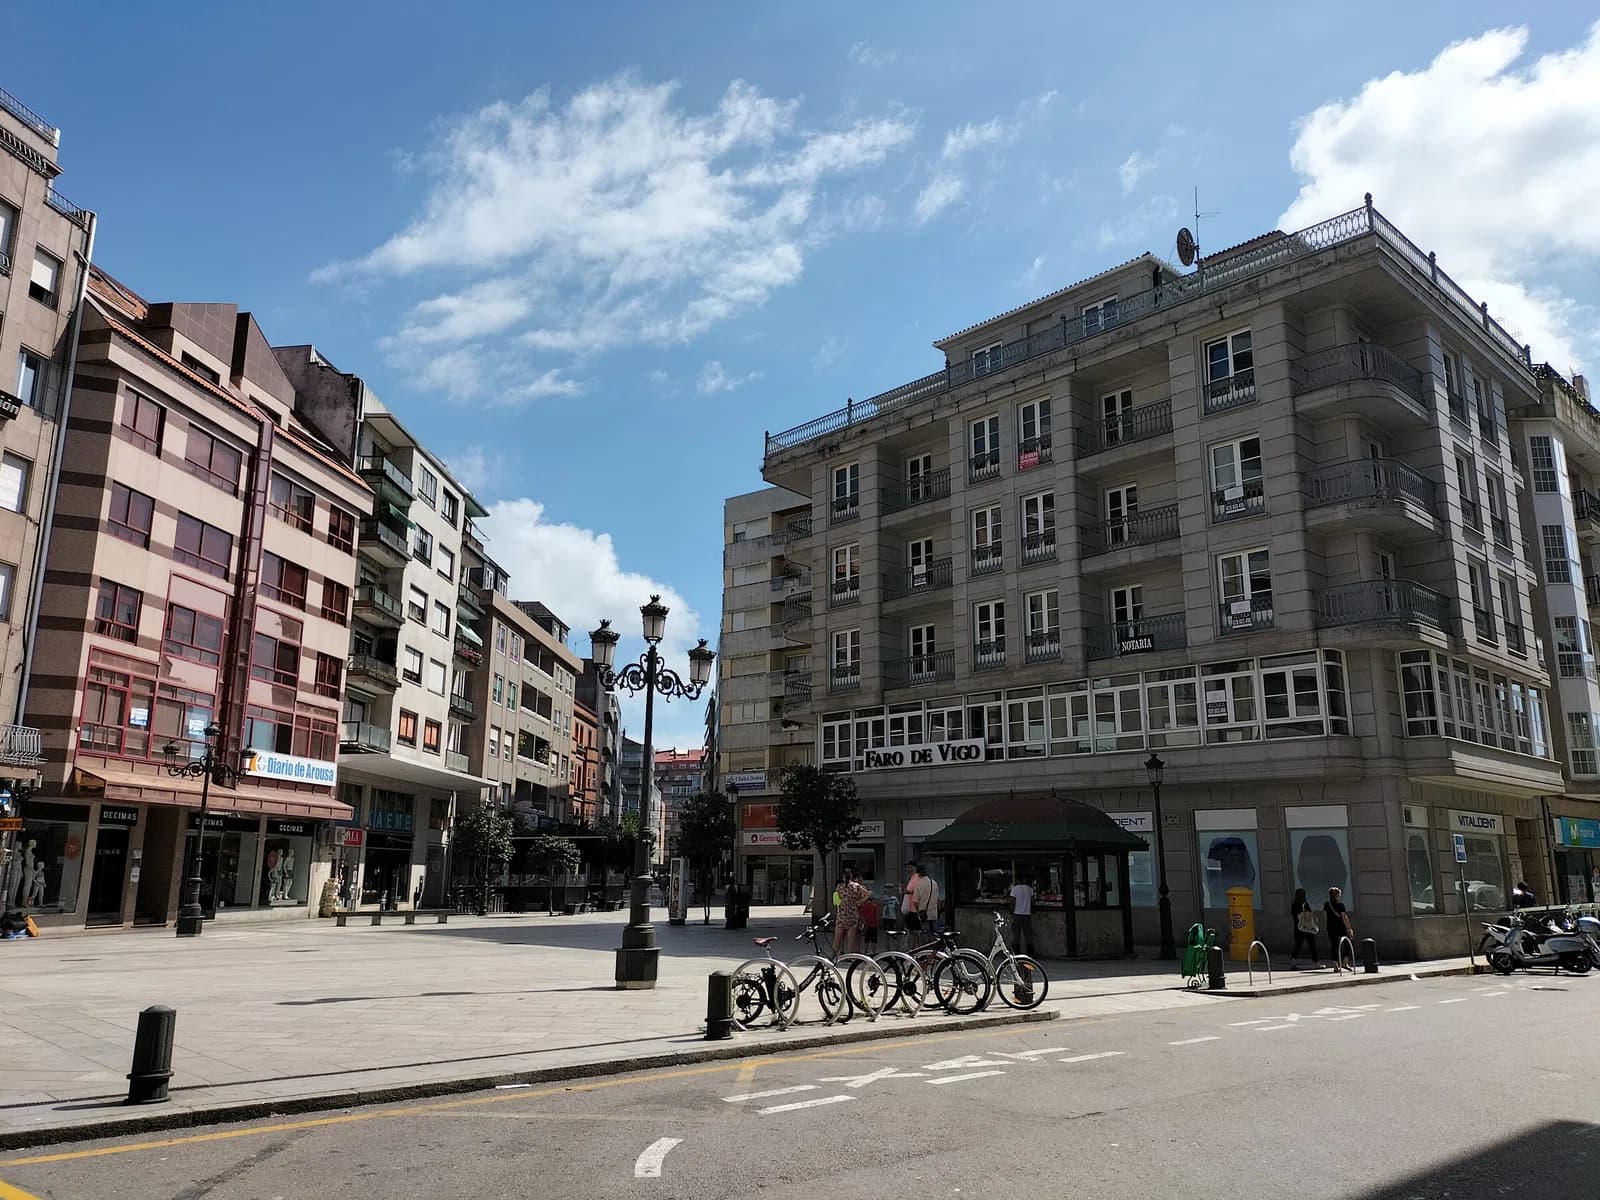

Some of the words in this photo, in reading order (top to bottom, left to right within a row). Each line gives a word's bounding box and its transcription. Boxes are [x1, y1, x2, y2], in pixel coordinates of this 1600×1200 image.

[865, 750, 904, 768] FARO
[910, 748, 932, 764] DE
[938, 743, 980, 761] VIGO
[267, 757, 293, 776] Diario
[295, 761, 304, 777] de
[306, 763, 334, 782] Arousa
[195, 818, 224, 827] DCIMAS
[1458, 815, 1496, 829] VITALDENT
[860, 825, 880, 833] DENT
[759, 833, 782, 842] General
